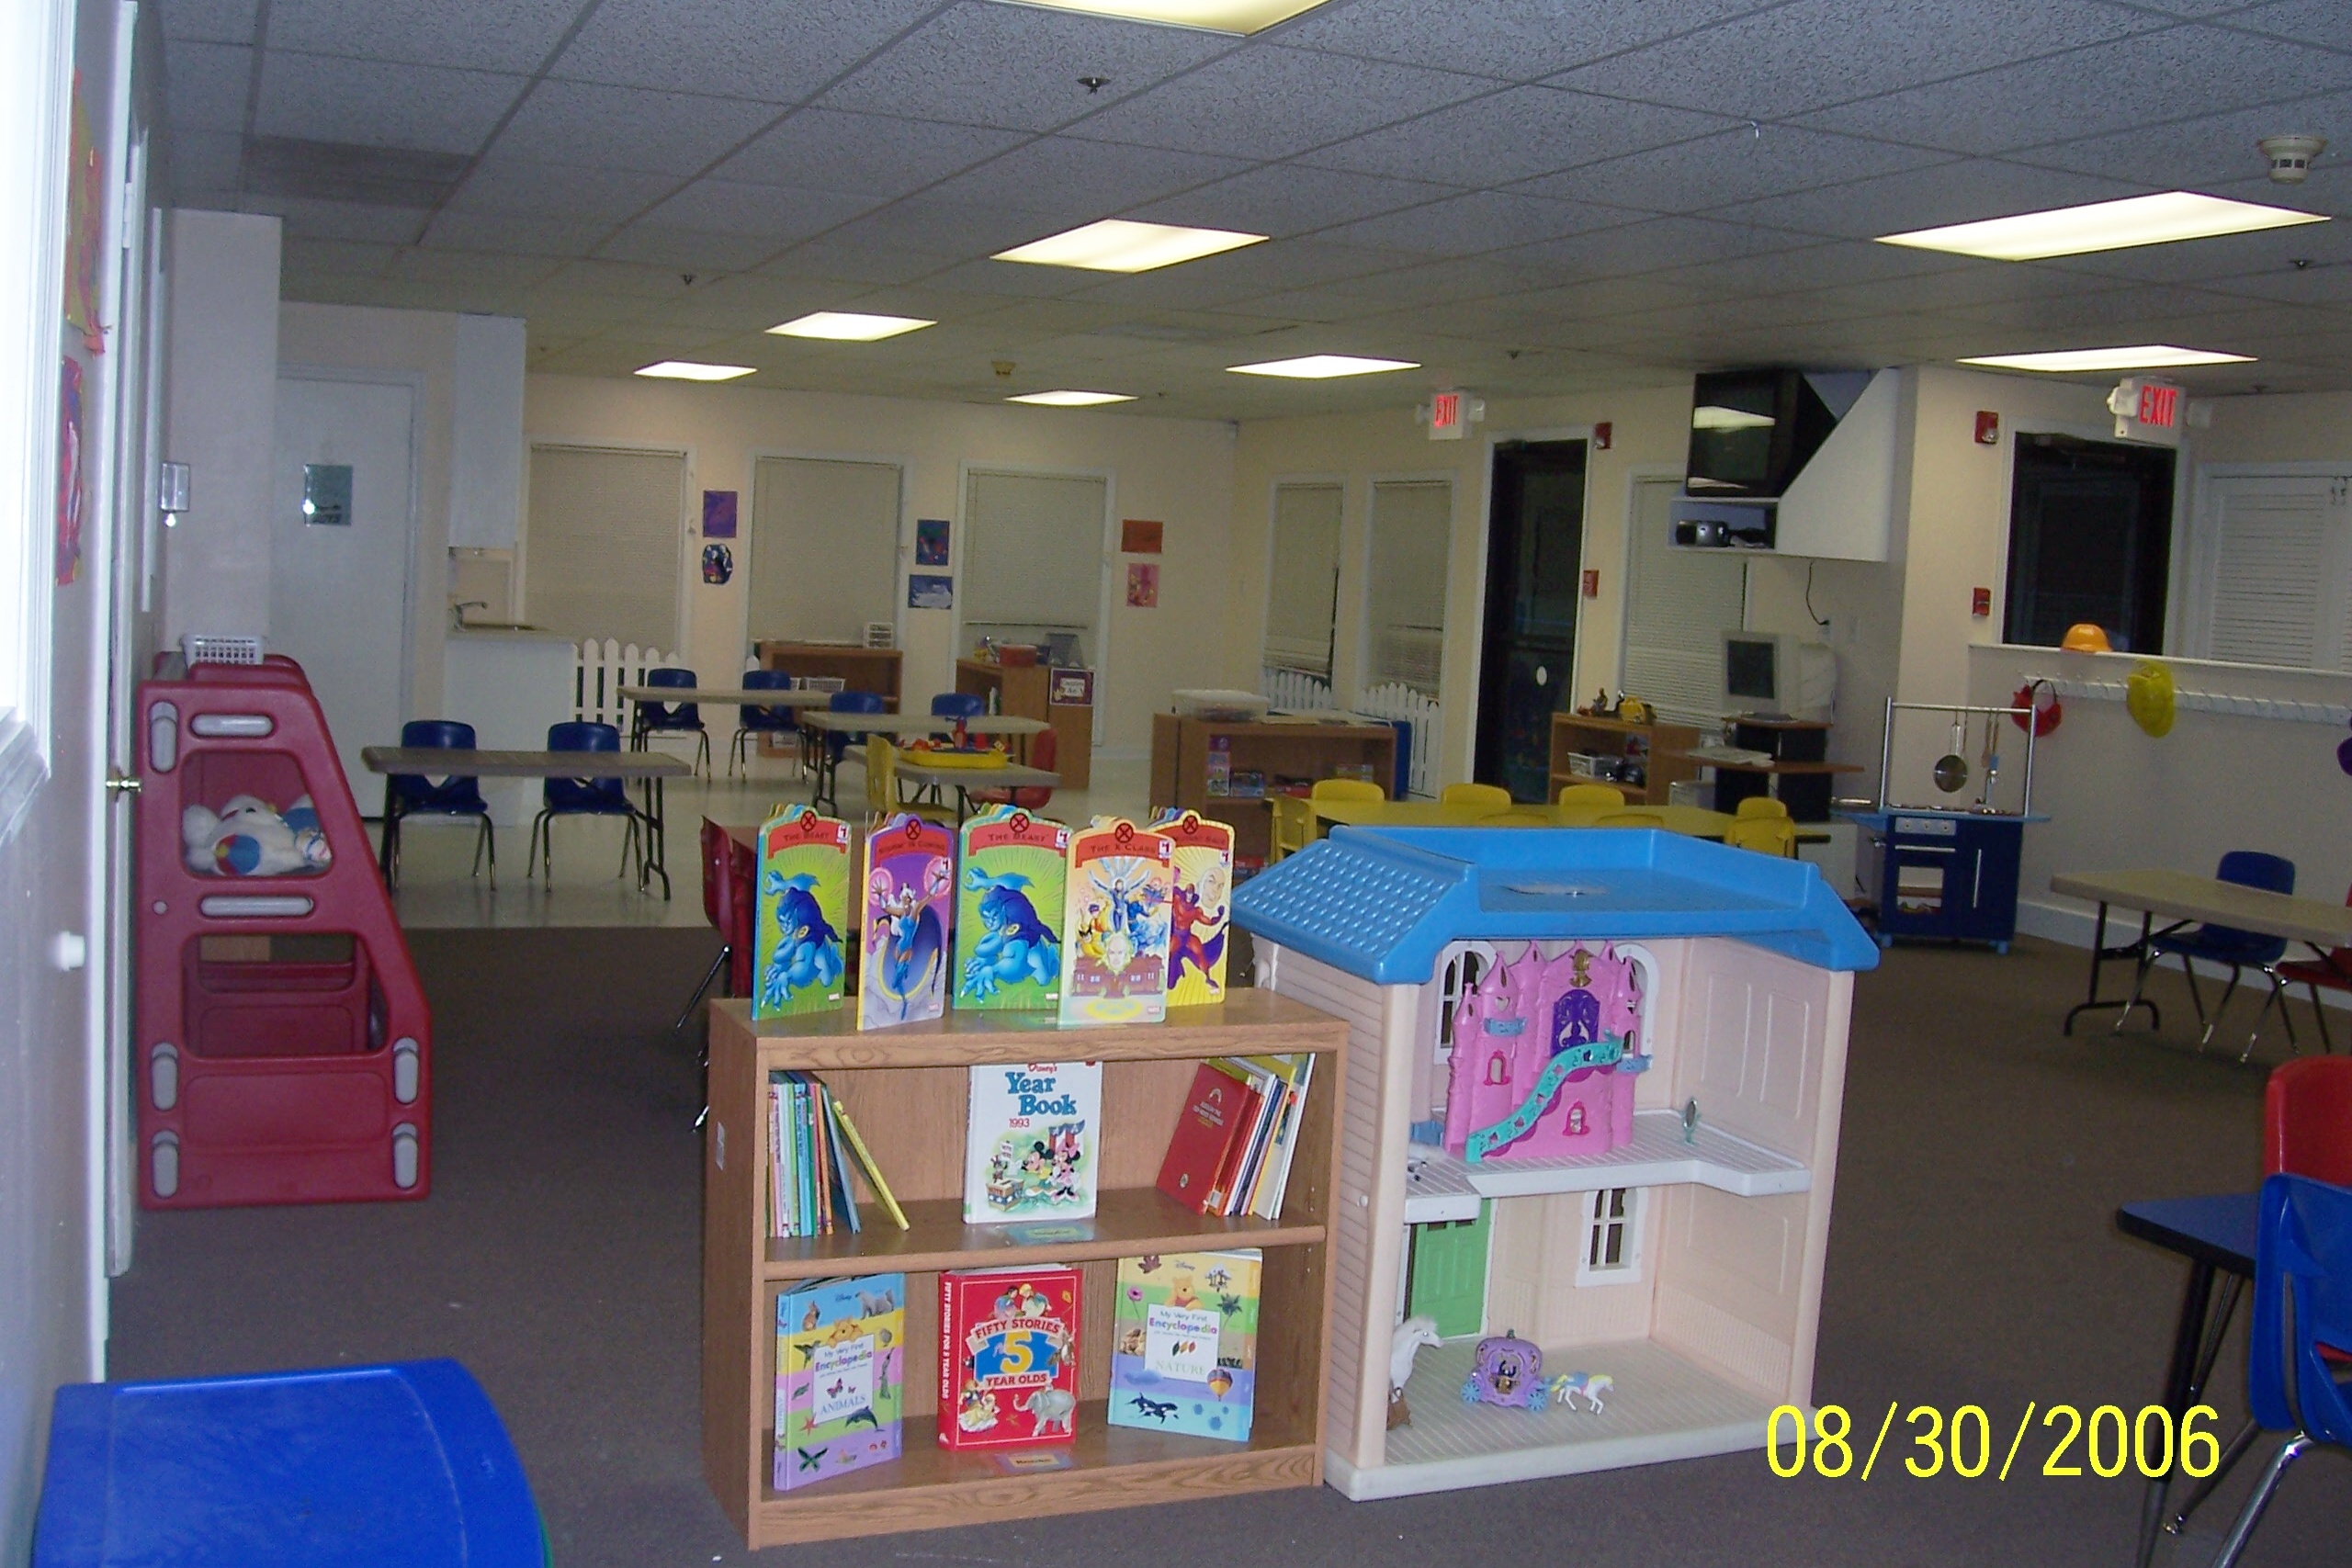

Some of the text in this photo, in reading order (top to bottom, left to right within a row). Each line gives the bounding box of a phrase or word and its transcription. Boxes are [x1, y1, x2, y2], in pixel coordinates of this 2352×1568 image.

[1434, 394, 1459, 427] EXIT
[2139, 385, 2178, 428] EXIT
[988, 832, 1046, 841] THE BEAST
[1004, 1071, 1056, 1094] Year
[1018, 1094, 1077, 1116] Book
[1009, 1118, 1030, 1128] 1993
[1160, 1310, 1171, 1319] My
[975, 1319, 1060, 1339] FIFTY STORIES
[1148, 1317, 1217, 1335] Encyclopedia
[815, 1349, 872, 1372] Encyclopedia
[1000, 1329, 1033, 1374] 5
[1156, 1360, 1205, 1375] NATURE
[986, 1373, 1047, 1387] YEAR OLDS
[820, 1395, 865, 1415] ANIMALS
